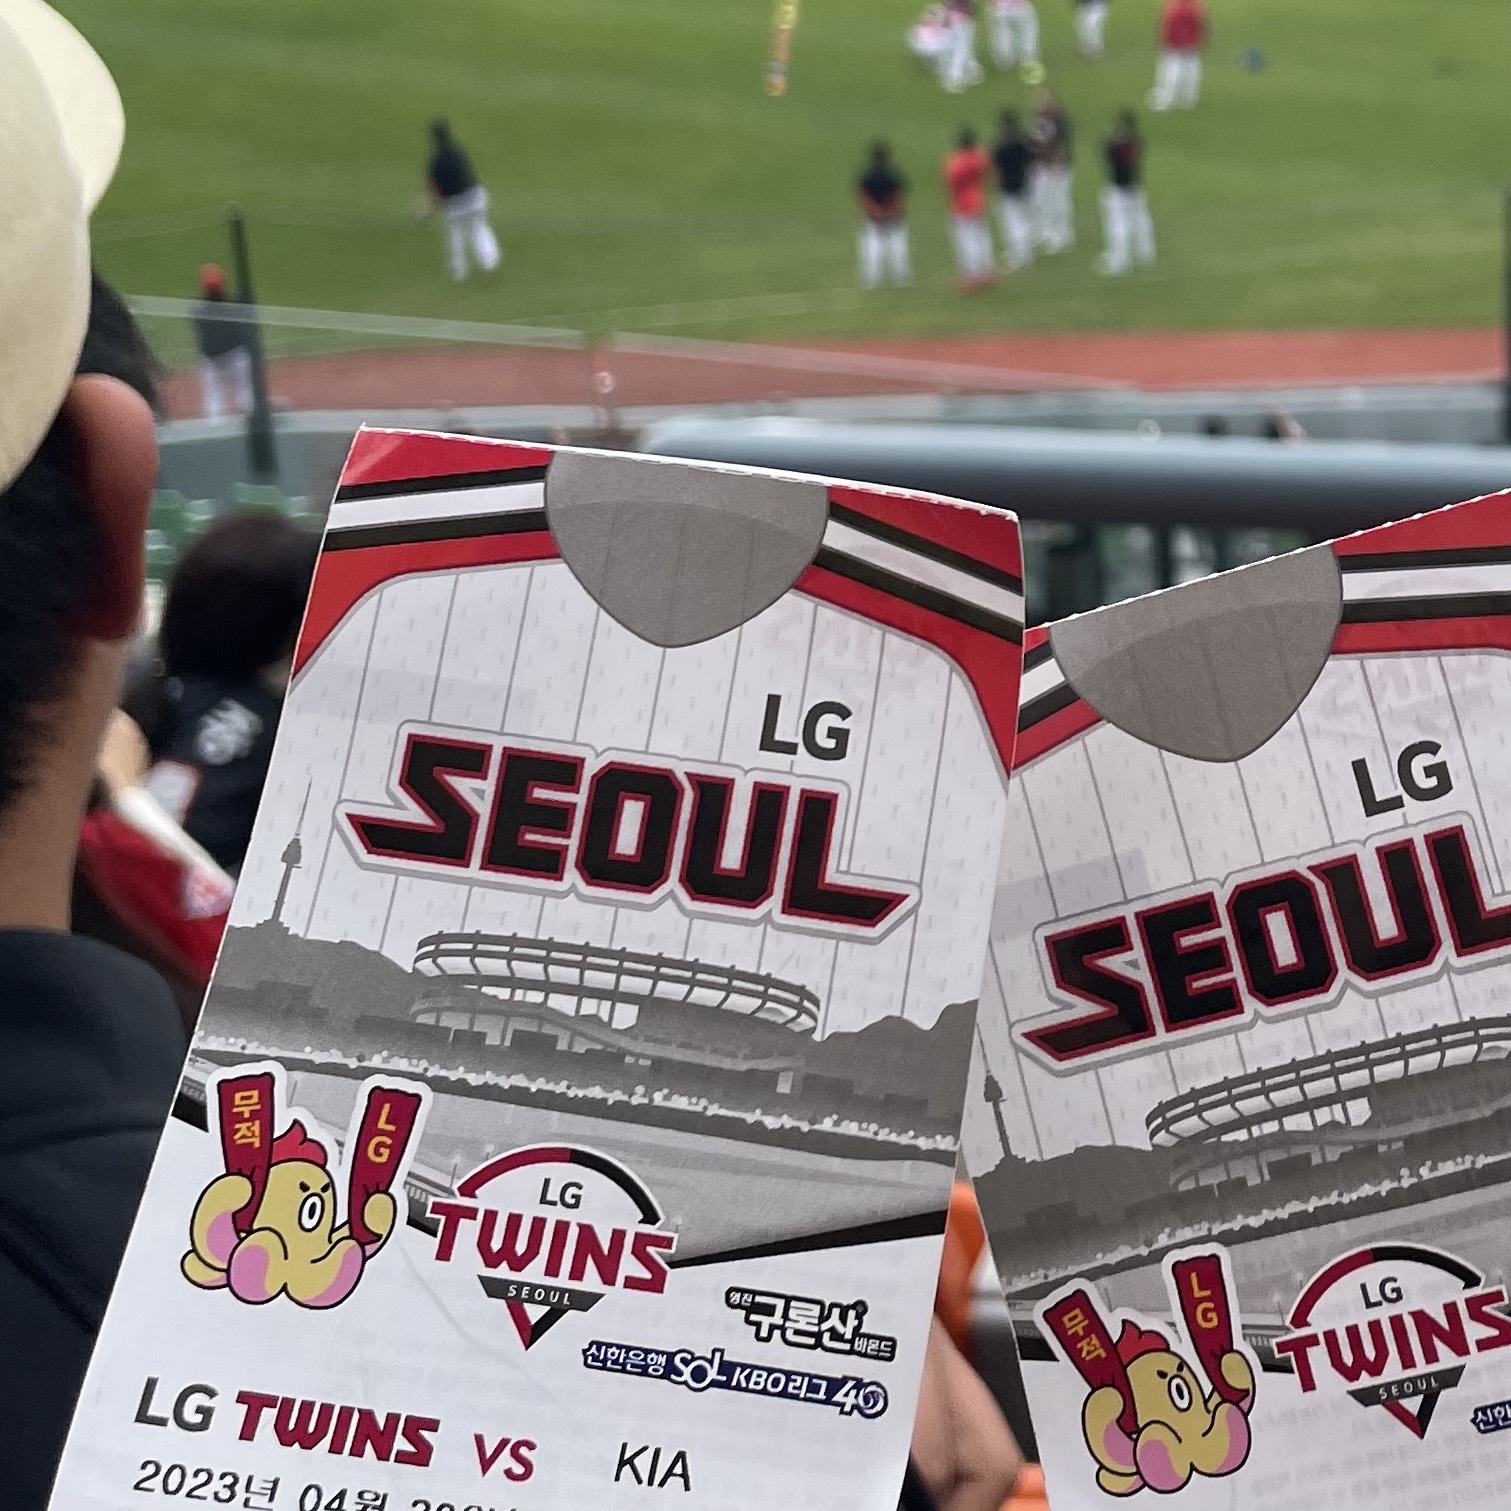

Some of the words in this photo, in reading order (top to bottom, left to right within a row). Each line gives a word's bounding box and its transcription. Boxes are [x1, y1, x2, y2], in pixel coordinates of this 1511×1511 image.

[758, 693, 853, 761] LG
[1351, 740, 1453, 818] LG
[344, 732, 910, 928] SEOUL
[232, 1089, 261, 1149] 무적
[367, 1103, 396, 1163] LG
[539, 1177, 584, 1210] LG
[429, 1200, 675, 1294] TWINS
[507, 1284, 572, 1305] SEOUL
[1189, 1272, 1219, 1329] LG
[1359, 1276, 1404, 1310] LG
[1062, 1308, 1107, 1361] 무적
[585, 1343, 667, 1375] 신한은행
[671, 1349, 727, 1389] SOL
[1379, 1376, 1440, 1401] SEOUL
[133, 1376, 219, 1432] LG
[235, 1390, 441, 1468] TWINS
[473, 1433, 538, 1482] VS
[614, 1442, 693, 1492] KIA
[133, 1459, 282, 1511] 2023년
